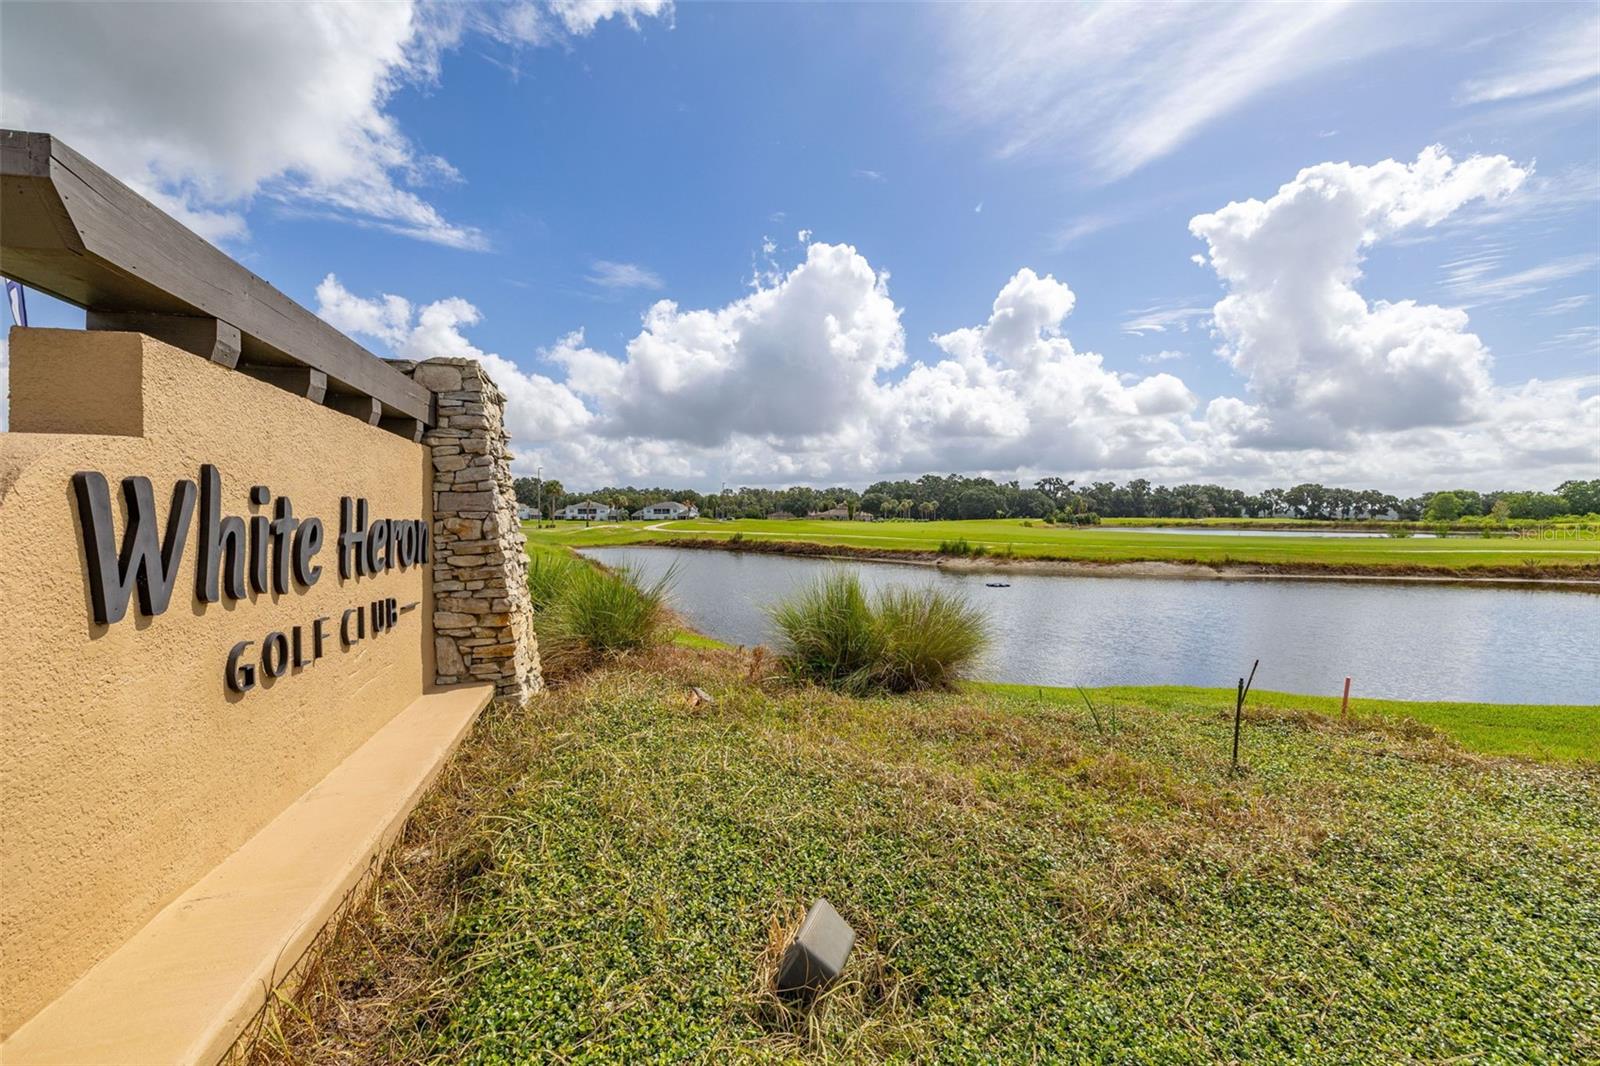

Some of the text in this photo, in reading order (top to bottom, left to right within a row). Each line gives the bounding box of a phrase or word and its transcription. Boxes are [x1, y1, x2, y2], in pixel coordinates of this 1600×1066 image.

[73, 463, 430, 625] White Heron
[225, 616, 330, 694] GOLF
